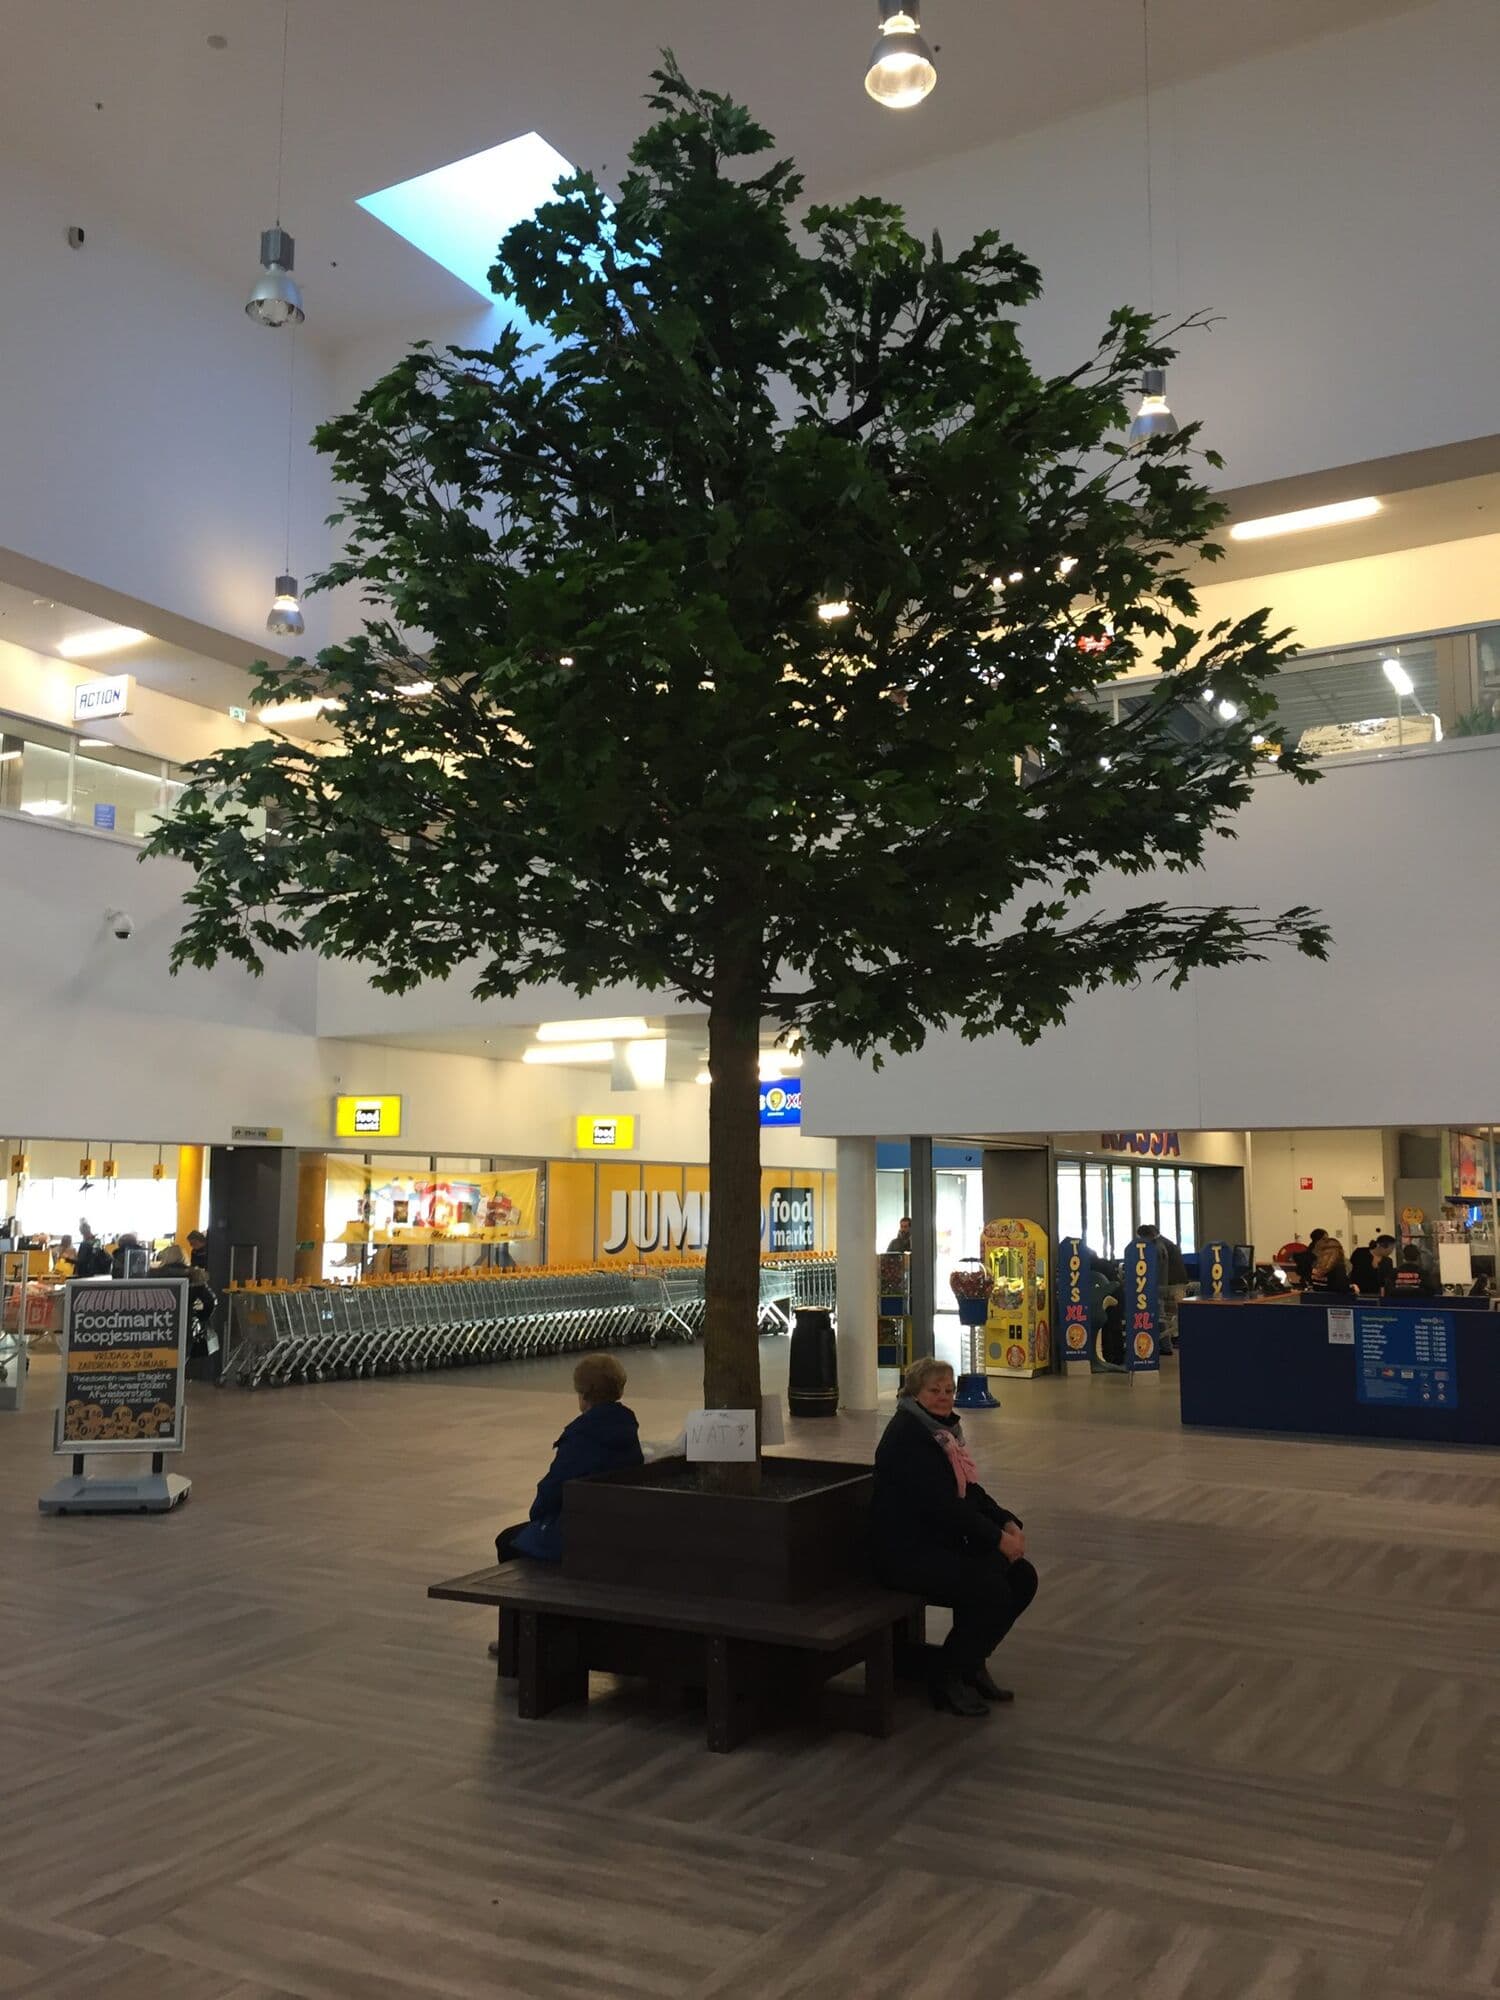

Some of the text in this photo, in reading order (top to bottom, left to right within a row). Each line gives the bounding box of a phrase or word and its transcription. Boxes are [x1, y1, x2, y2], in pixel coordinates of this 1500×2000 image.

[79, 688, 121, 709] ACTION
[603, 1190, 813, 1254] JUM food
[772, 1224, 813, 1246] markt
[1069, 1240, 1081, 1303] TOYS
[1135, 1242, 1147, 1310] TOYS
[1211, 1245, 1224, 1297] TOY
[74, 1311, 174, 1329] Foodmarkt
[1065, 1305, 1088, 1322] XL
[1132, 1312, 1153, 1330] XL
[73, 1328, 173, 1346] koopjesmarkt
